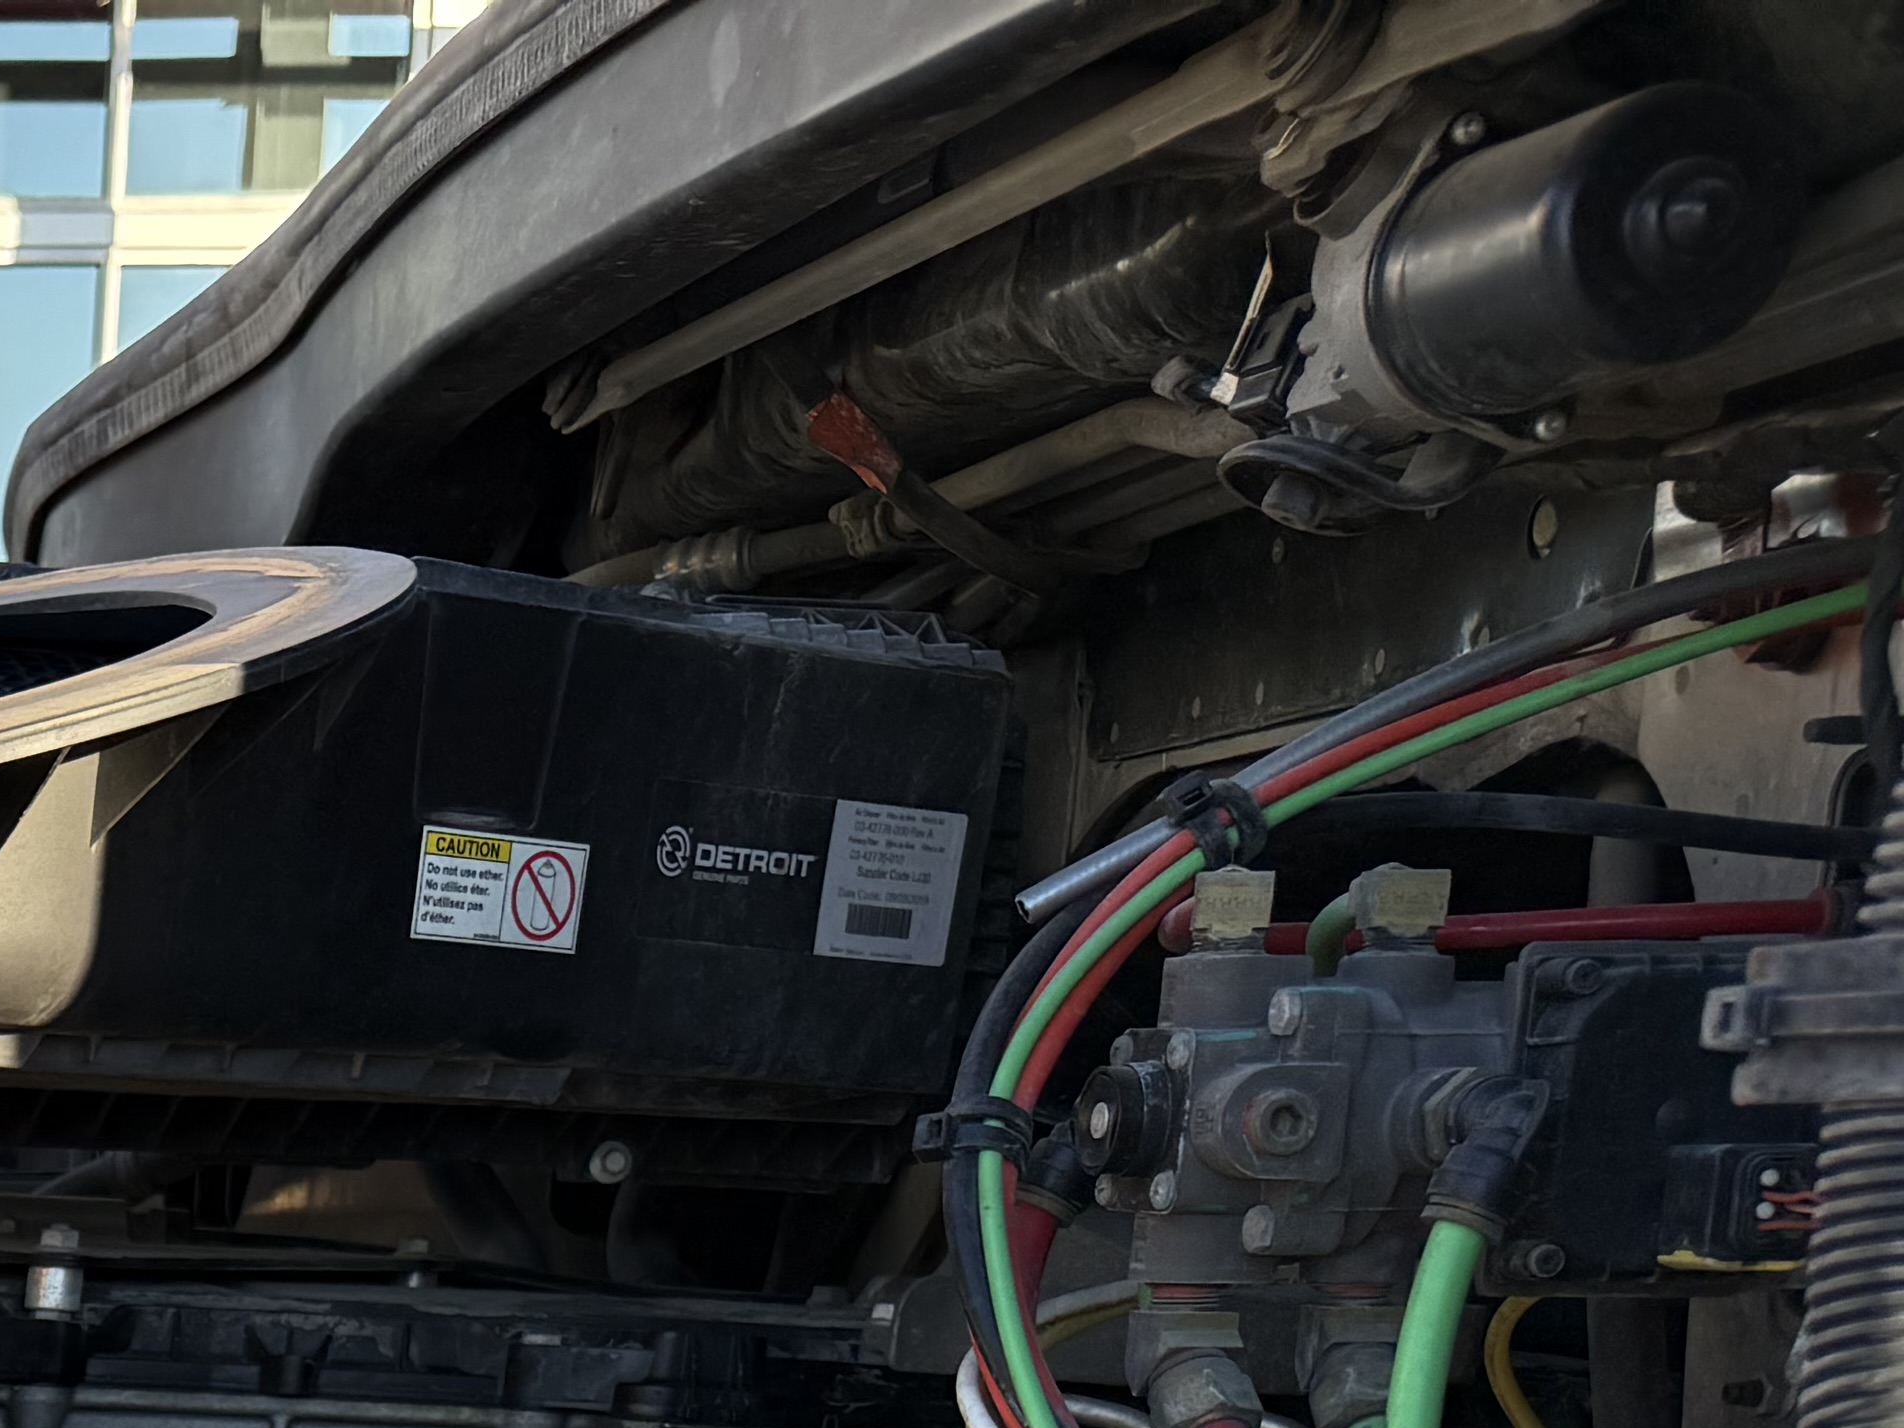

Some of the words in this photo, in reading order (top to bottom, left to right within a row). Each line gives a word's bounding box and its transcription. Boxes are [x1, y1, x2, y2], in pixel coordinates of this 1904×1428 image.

[435, 836, 502, 860] CAUTION
[694, 842, 815, 878] DETROIT
[426, 862, 439, 874] Do
[442, 864, 458, 877] not
[460, 868, 477, 879] use
[478, 866, 504, 882] ether.
[425, 879, 439, 892] No
[440, 880, 468, 894] utilice
[470, 882, 491, 897] éter.
[467, 902, 484, 913] pas
